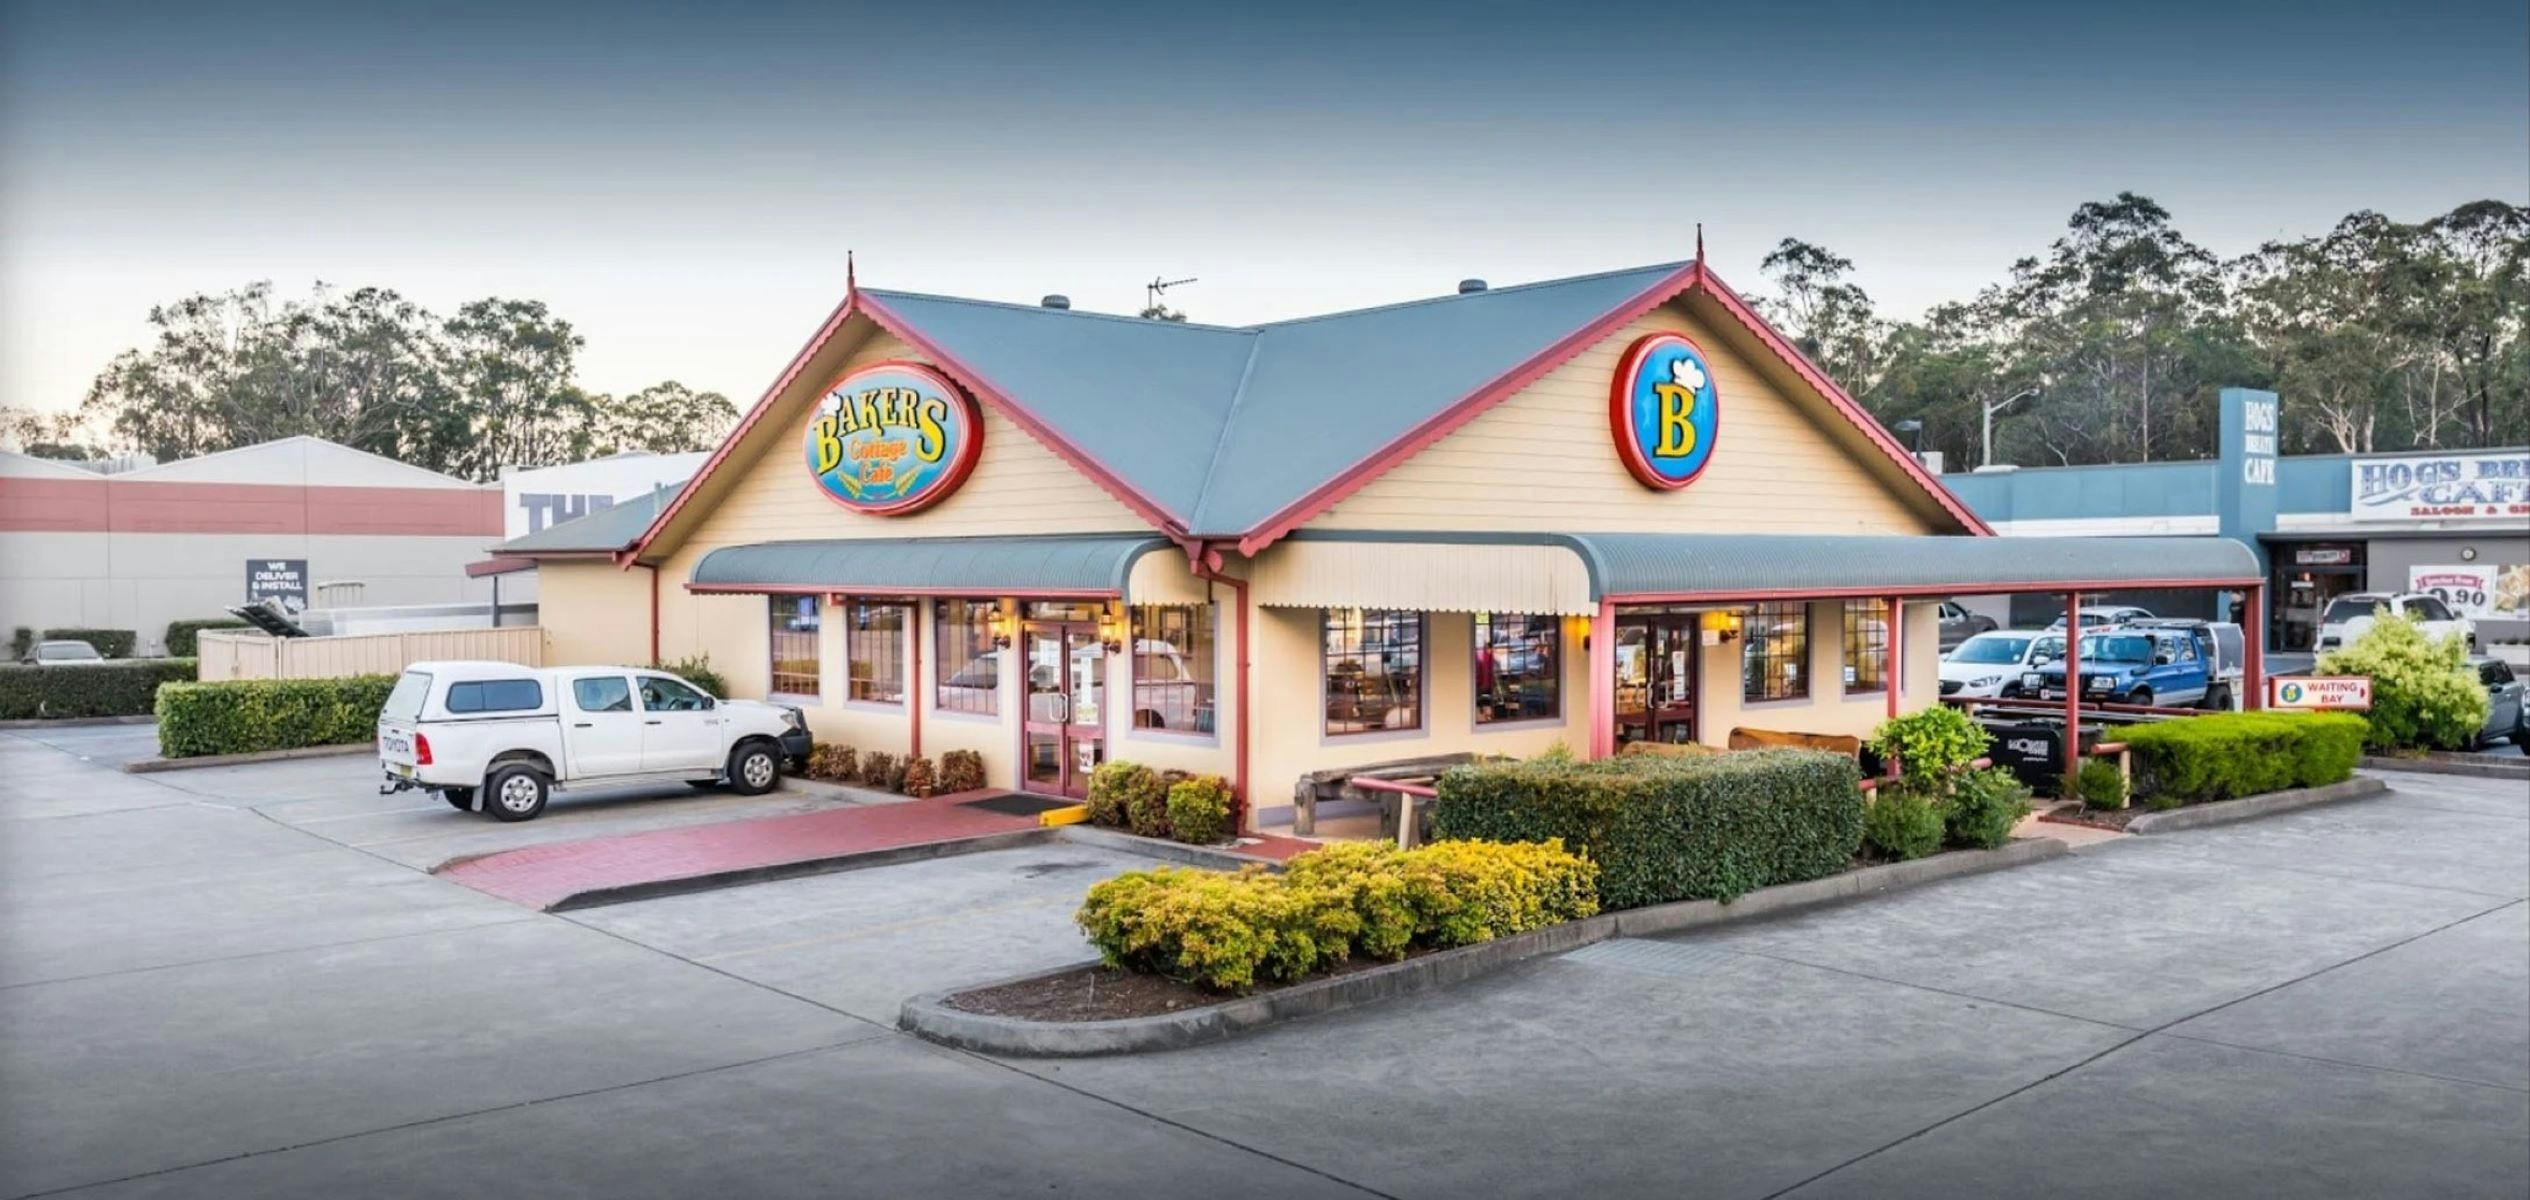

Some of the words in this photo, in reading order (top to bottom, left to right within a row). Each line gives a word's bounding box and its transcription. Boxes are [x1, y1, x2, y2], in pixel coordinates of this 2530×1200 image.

[1653, 381, 1698, 458] B
[813, 387, 948, 476] BAKERS
[850, 439, 908, 461] Cottage
[2410, 506, 2475, 516] SALOON
[2485, 506, 2498, 515] &
[266, 561, 286, 571] WE
[255, 571, 299, 581] DELIVER
[261, 581, 304, 590] INSTALL
[2307, 682, 2357, 692] WAITING
[2321, 694, 2344, 703] BAY
